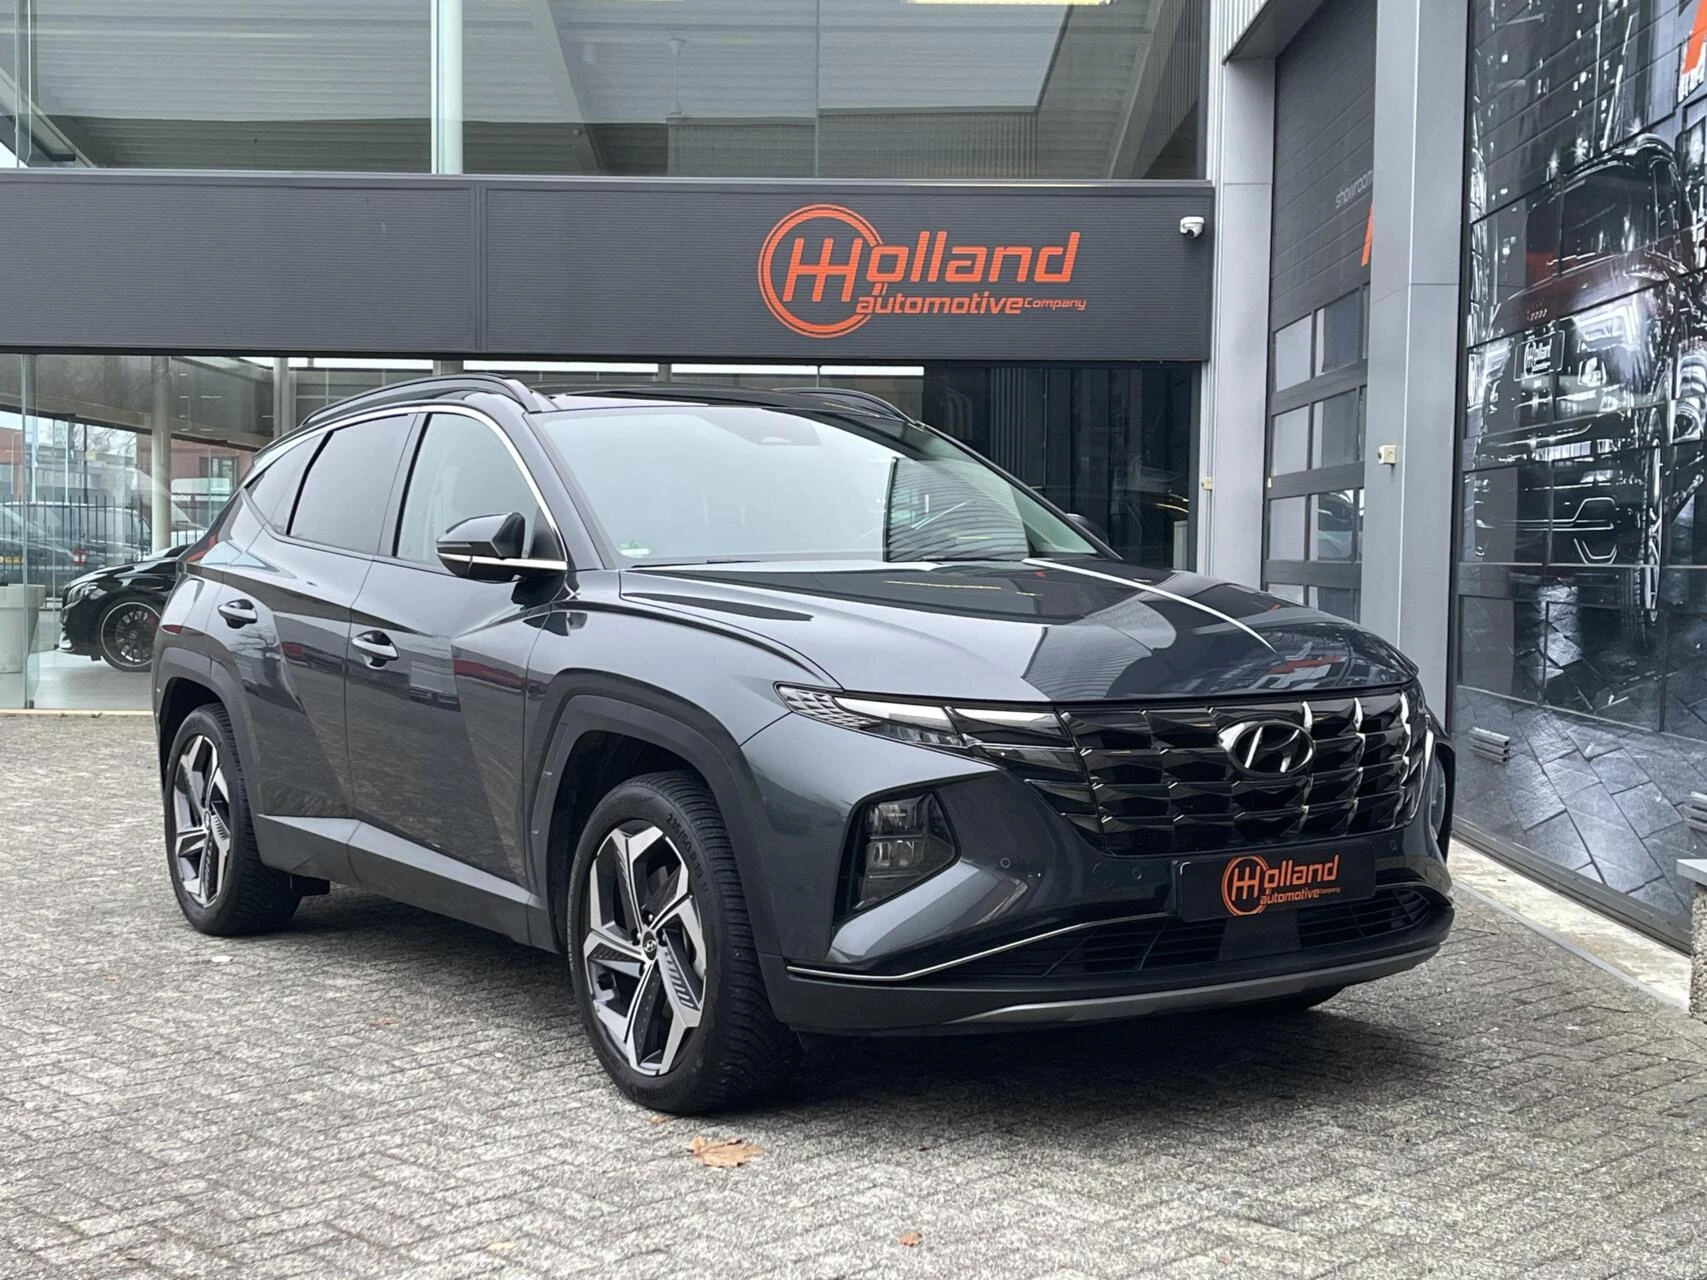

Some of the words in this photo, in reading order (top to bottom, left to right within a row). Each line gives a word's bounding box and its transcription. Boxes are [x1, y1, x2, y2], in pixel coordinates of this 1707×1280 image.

[782, 231, 1080, 302] Holland
[856, 290, 1023, 315] automotive
[1024, 297, 1087, 311] Company
[1232, 854, 1340, 902] Holland
[1259, 887, 1320, 905] automotive
